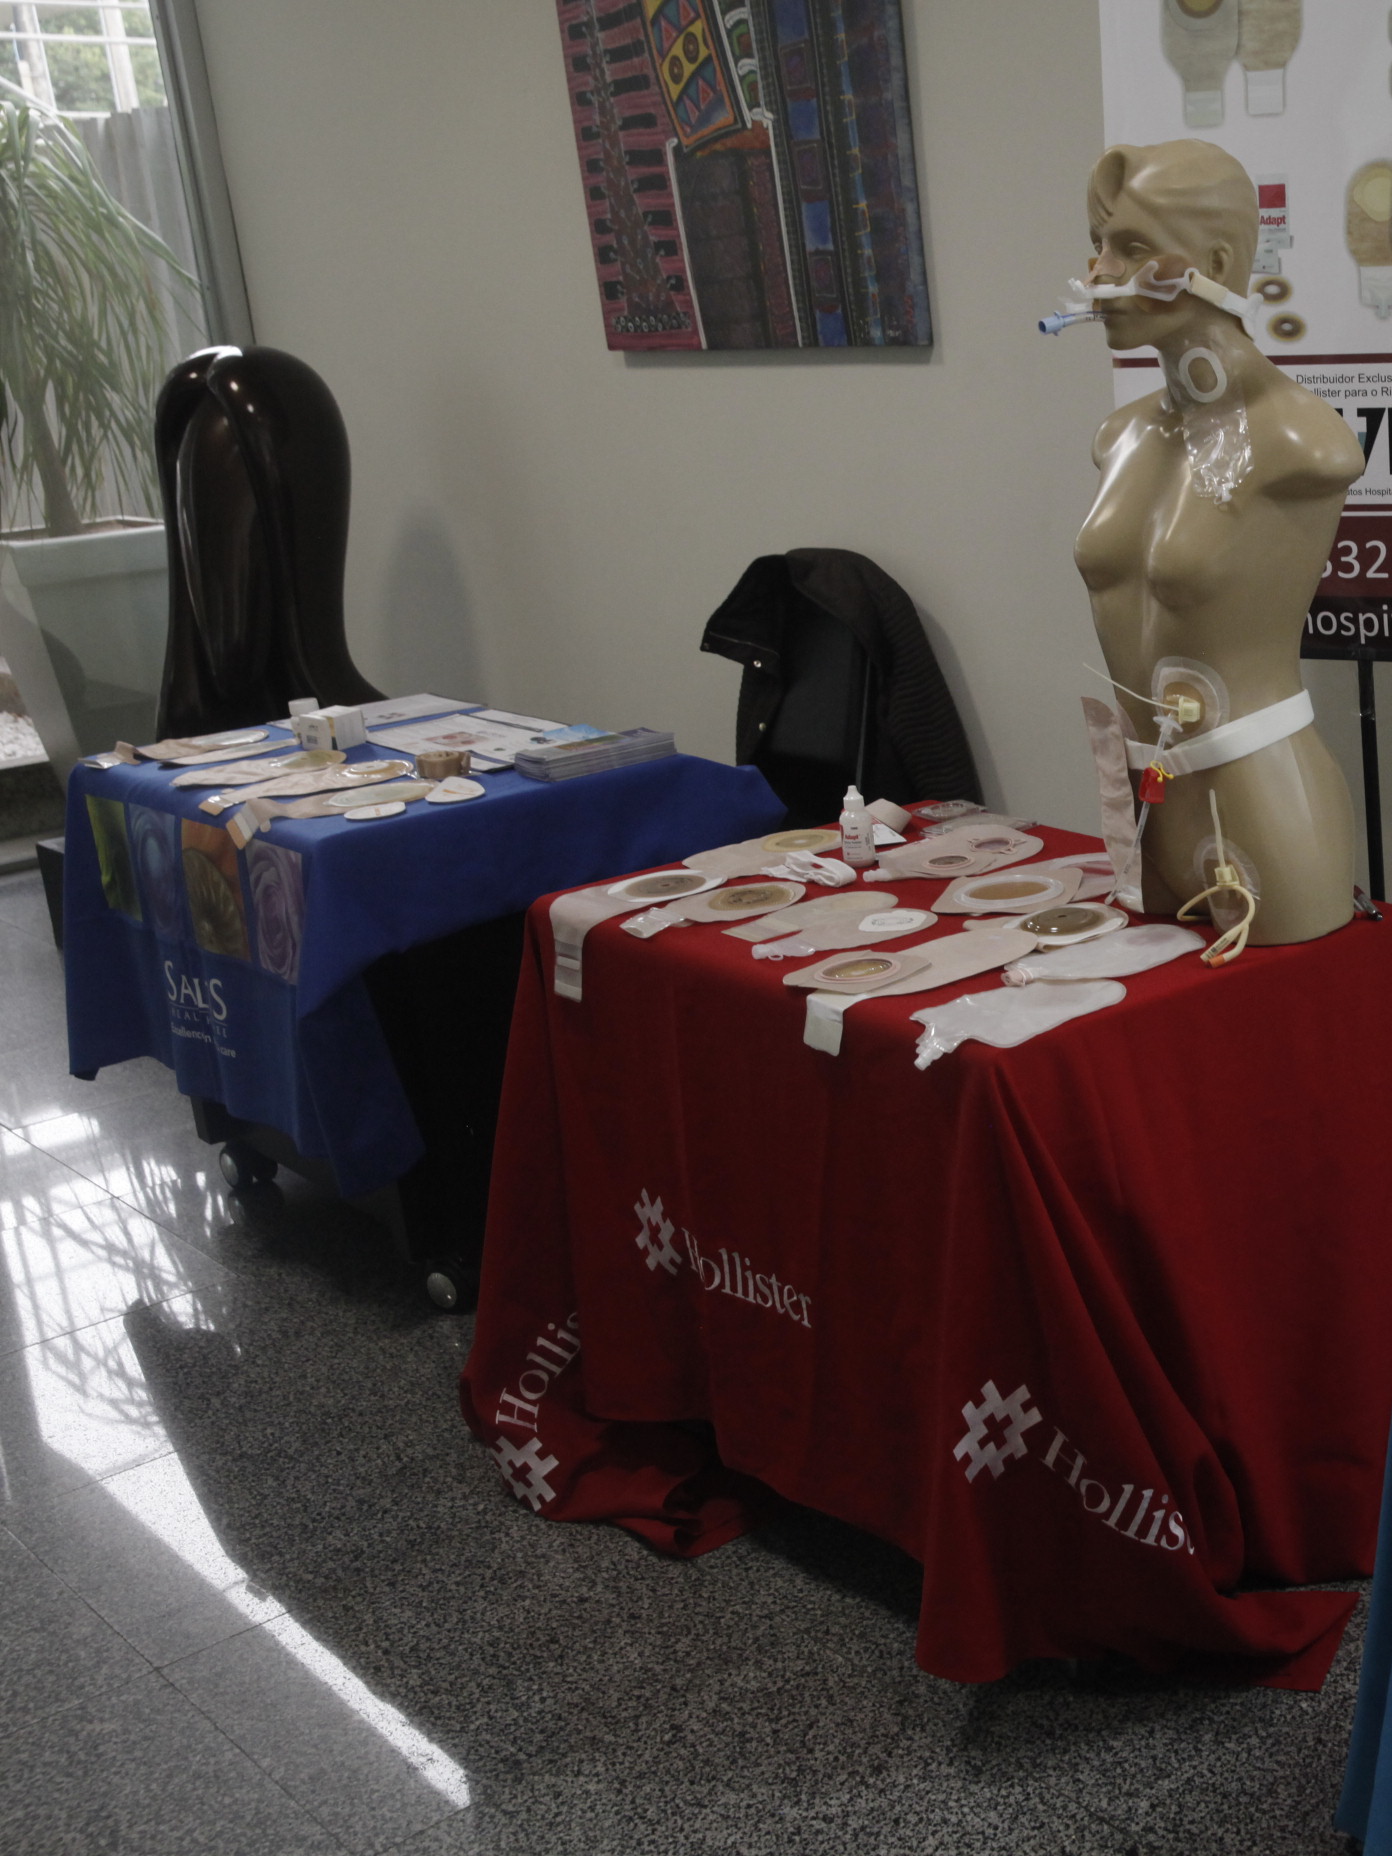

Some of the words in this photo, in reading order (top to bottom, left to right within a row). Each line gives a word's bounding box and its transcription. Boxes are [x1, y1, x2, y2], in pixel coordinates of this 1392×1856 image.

[1260, 215, 1286, 227] Adapt
[1296, 373, 1354, 385] Distribuidor
[1344, 388, 1368, 399] para
[1371, 389, 1378, 397] o
[1039, 1425, 1195, 1555] Hollis
